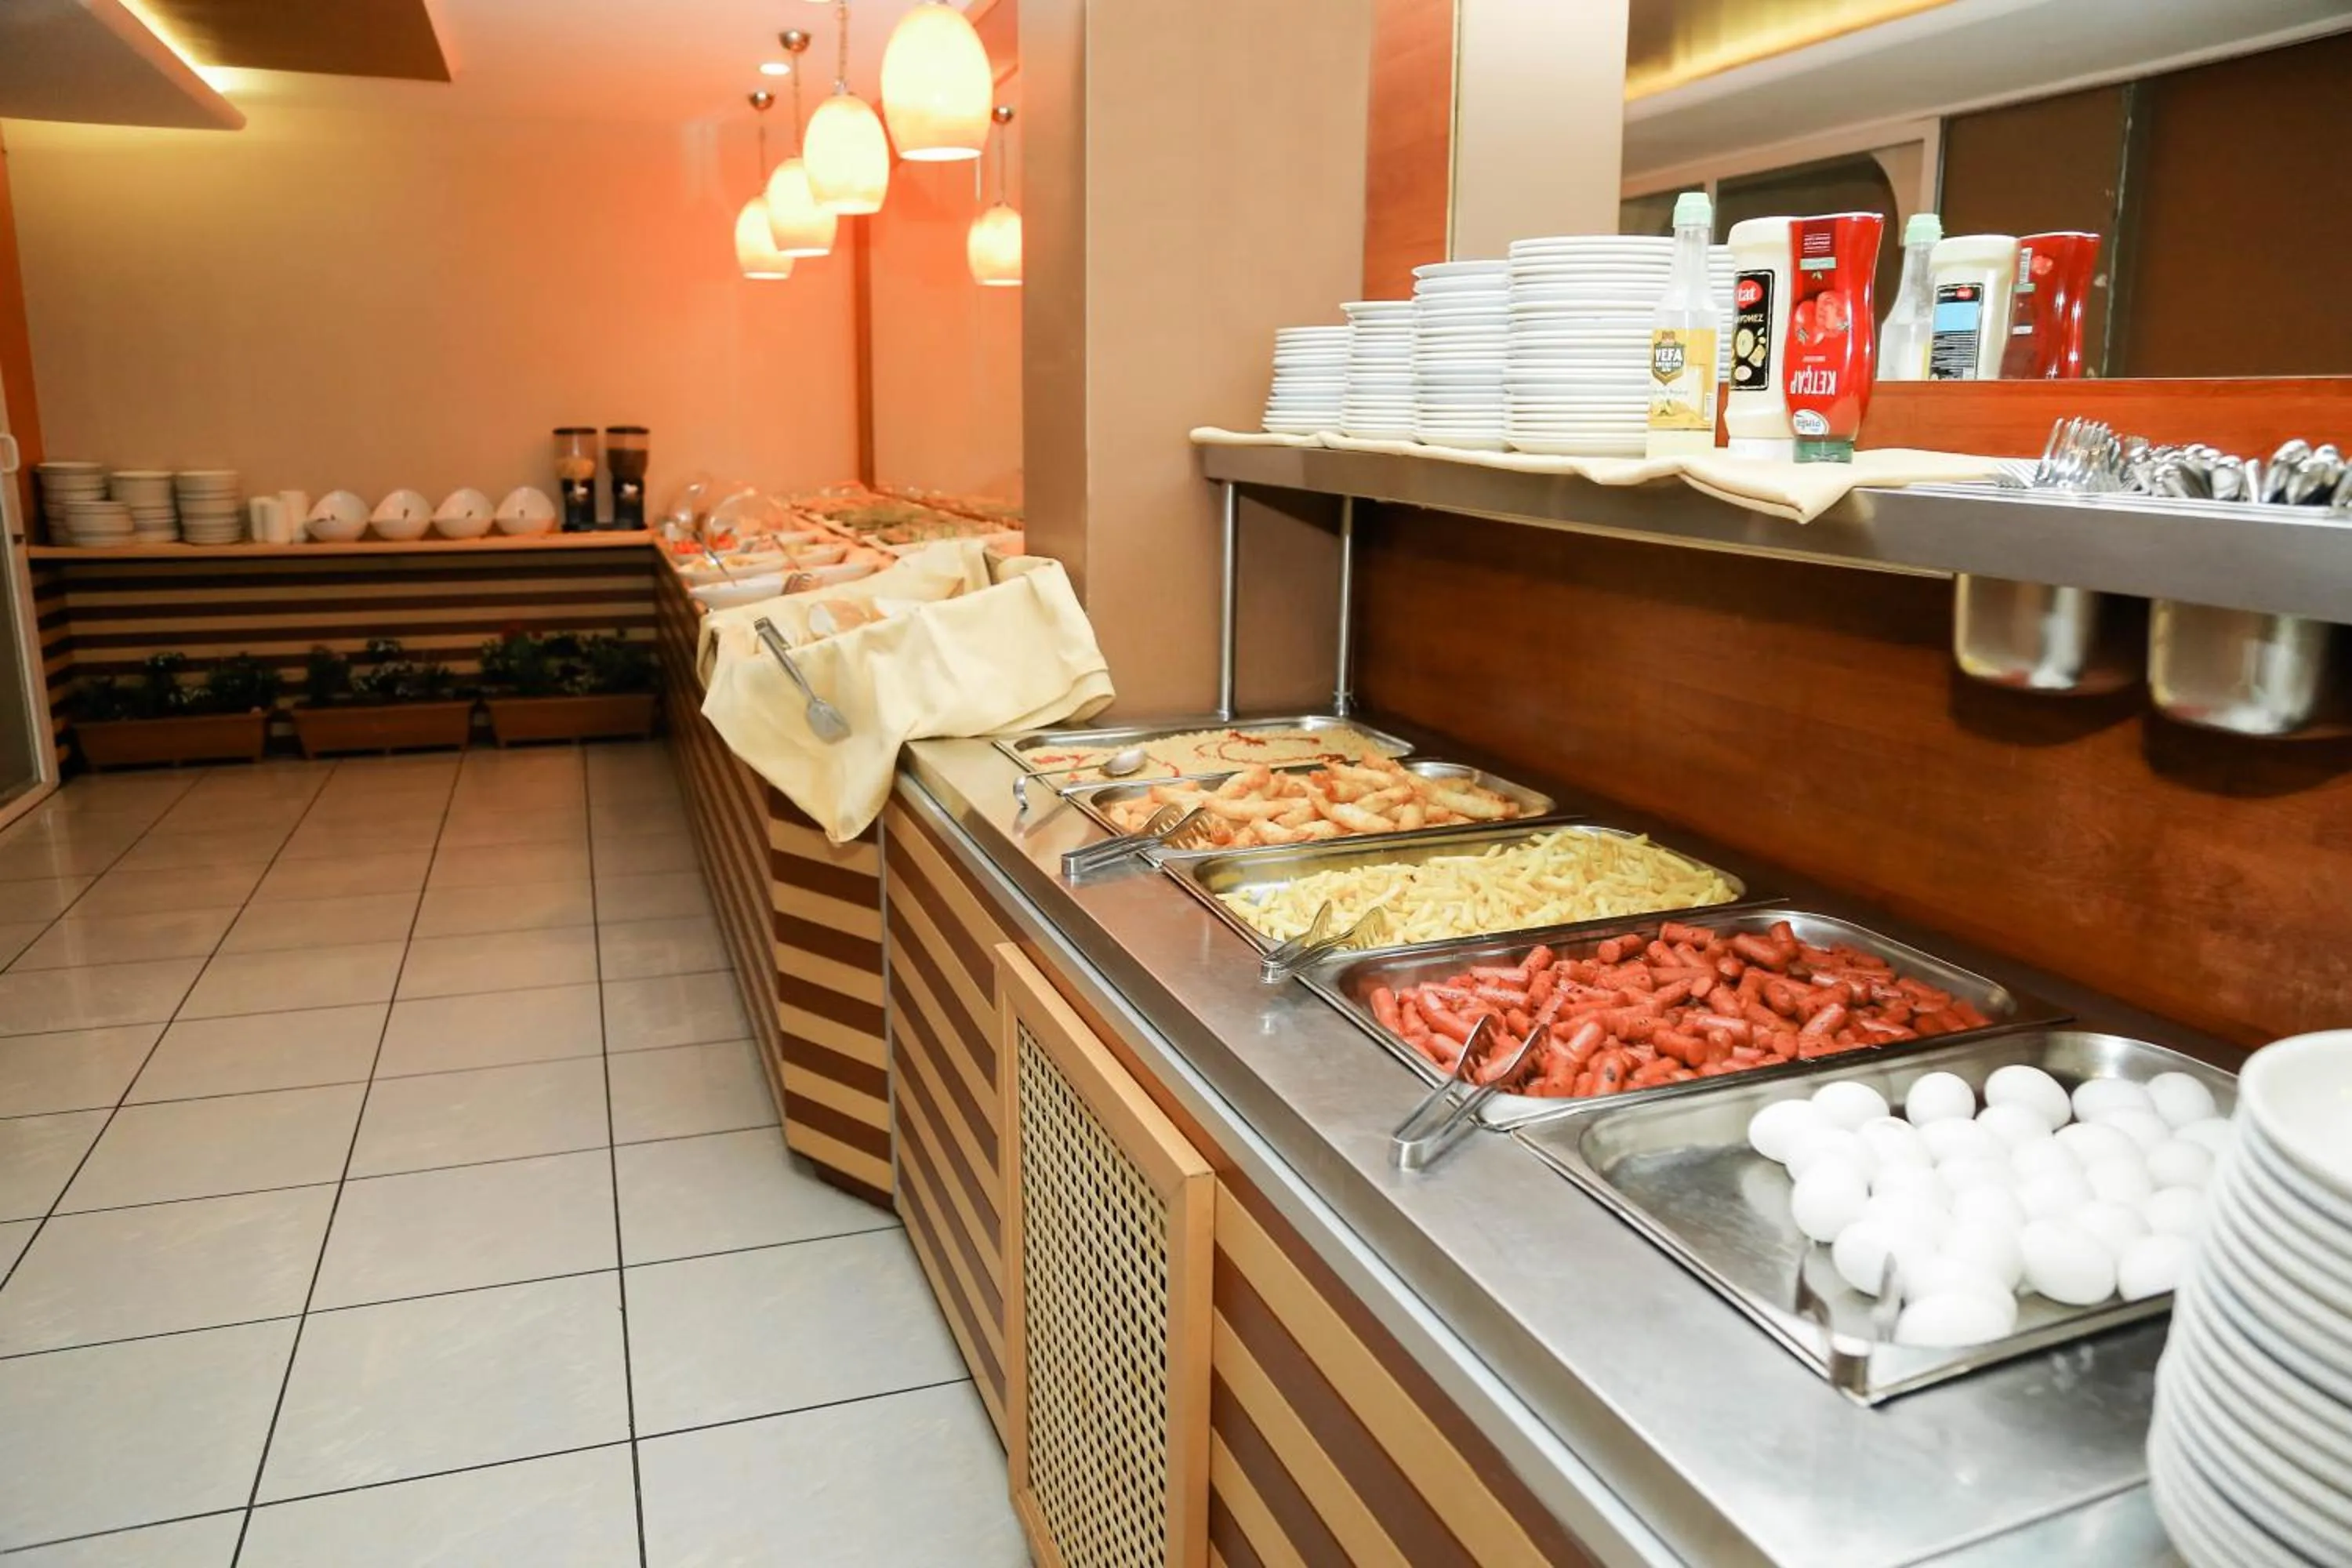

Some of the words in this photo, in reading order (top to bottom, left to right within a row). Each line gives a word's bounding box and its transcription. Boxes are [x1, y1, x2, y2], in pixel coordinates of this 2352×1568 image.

[1738, 287, 1757, 302] tat
[1655, 348, 1682, 361] VEFA
[1790, 365, 1837, 395] KETÇAP
